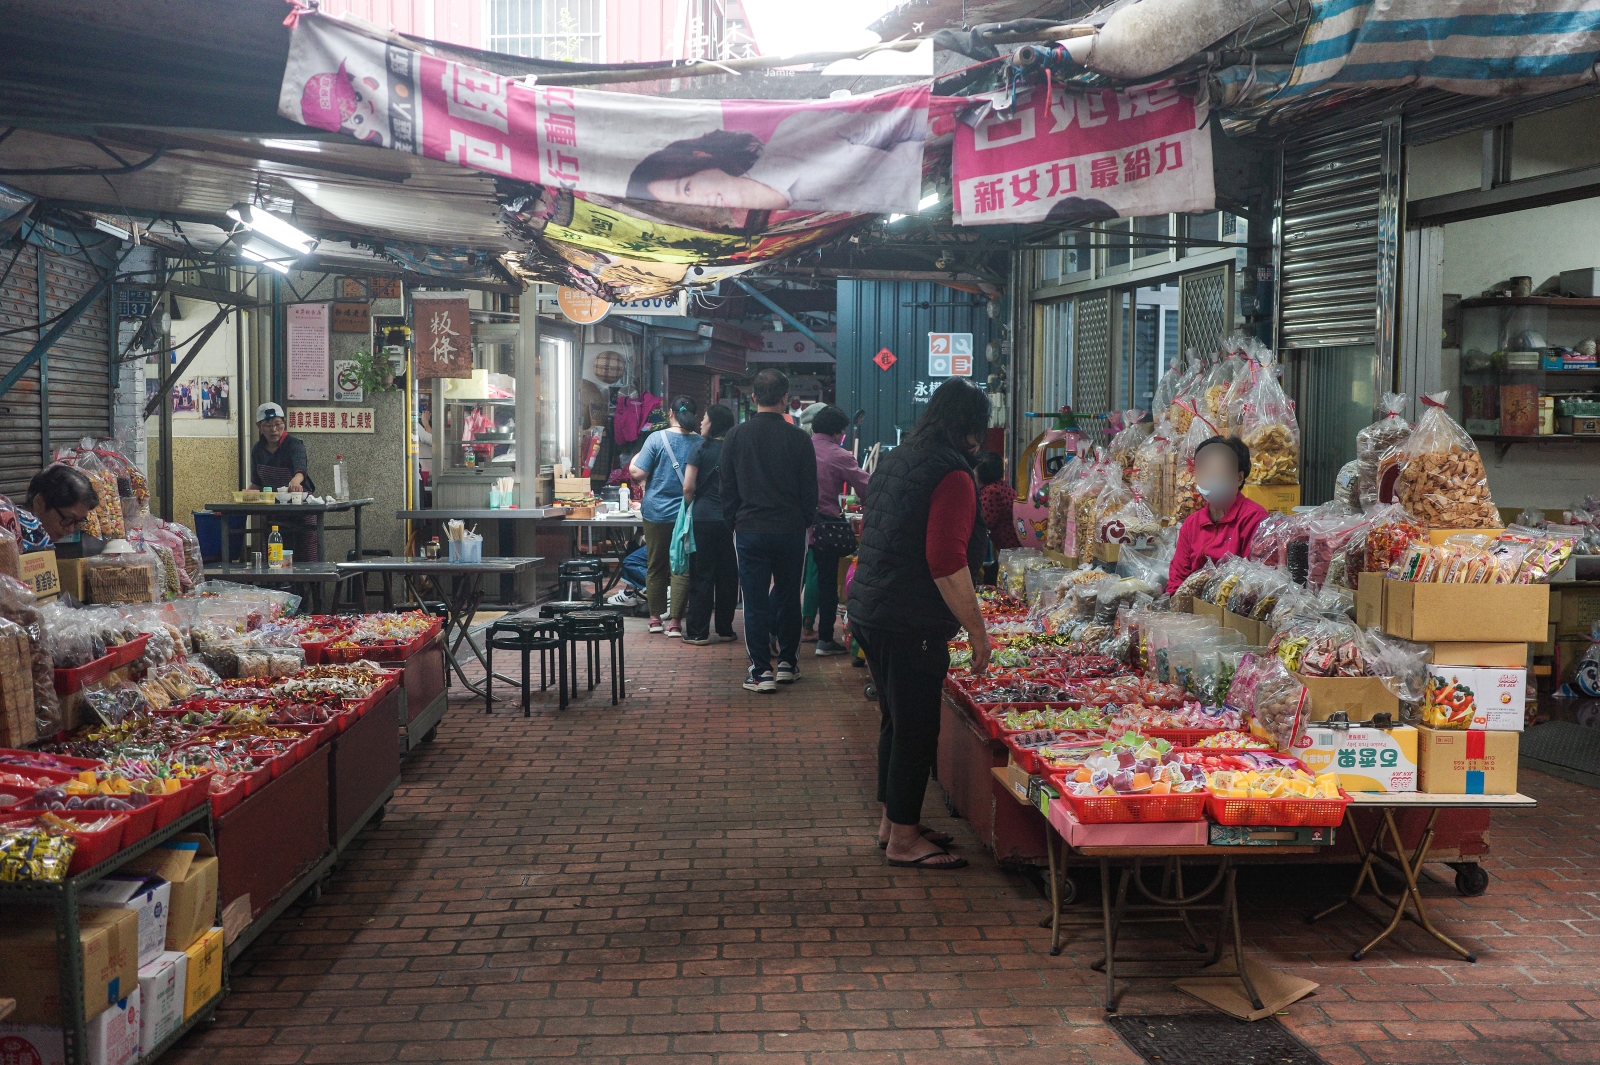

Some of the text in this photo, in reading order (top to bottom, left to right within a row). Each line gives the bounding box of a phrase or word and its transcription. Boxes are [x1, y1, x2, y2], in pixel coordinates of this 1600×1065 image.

[974, 140, 1183, 214] 新女力 最給力
[131, 303, 147, 314] 37
[428, 310, 461, 365] 粄條
[1337, 748, 1398, 768] 百香果
